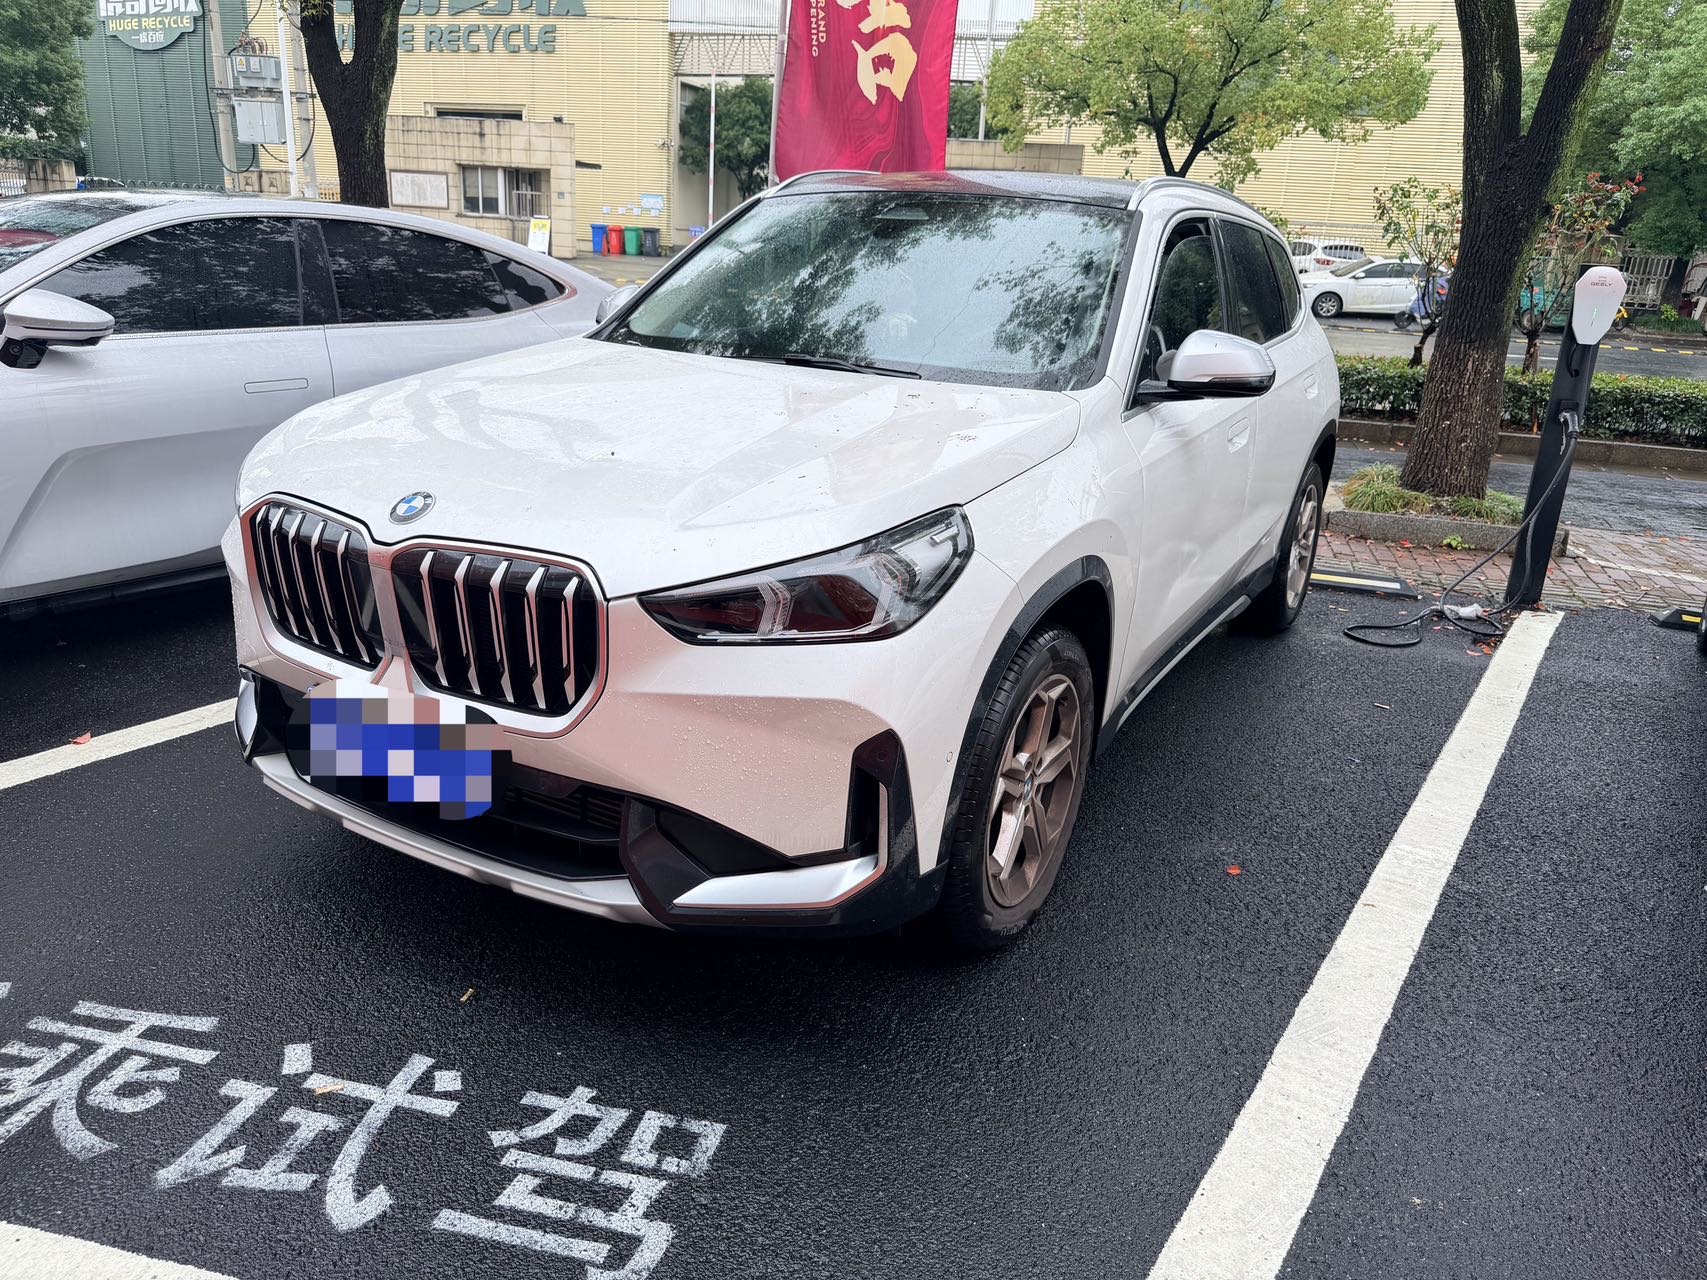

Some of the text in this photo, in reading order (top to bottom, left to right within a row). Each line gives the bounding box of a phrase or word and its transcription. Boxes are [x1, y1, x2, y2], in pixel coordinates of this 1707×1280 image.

[109, 15, 190, 31] HUGE RECYCLE
[337, 24, 556, 52] HE RECYCLE
[0, 982, 727, 1280] 乘试驾
